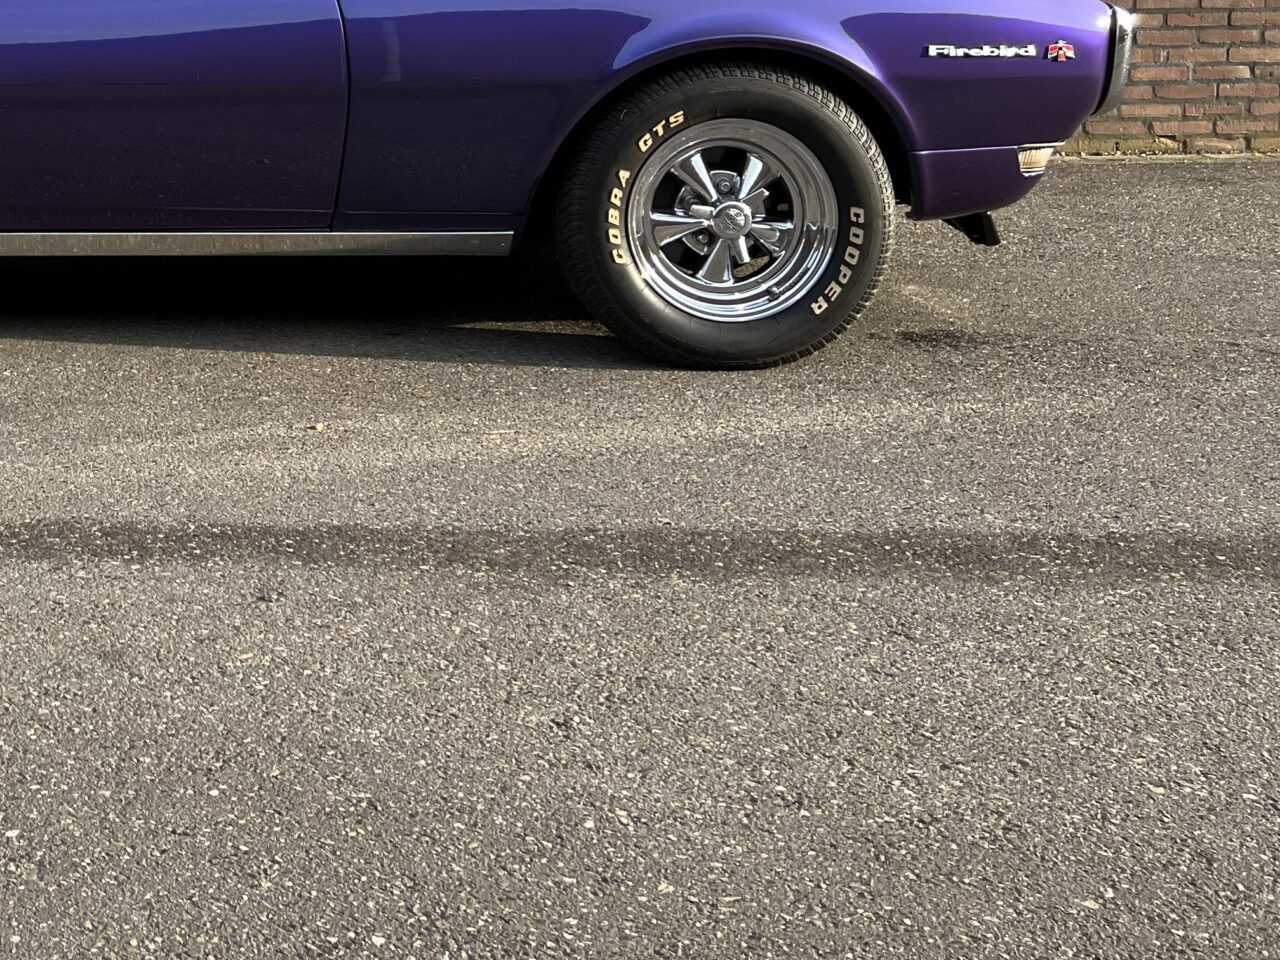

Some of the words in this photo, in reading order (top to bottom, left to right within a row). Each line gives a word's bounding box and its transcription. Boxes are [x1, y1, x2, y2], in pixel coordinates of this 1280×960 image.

[928, 45, 1036, 57] Firebird
[608, 169, 631, 264] COBRA
[638, 110, 684, 152] GTS
[810, 206, 865, 315] COOPER
